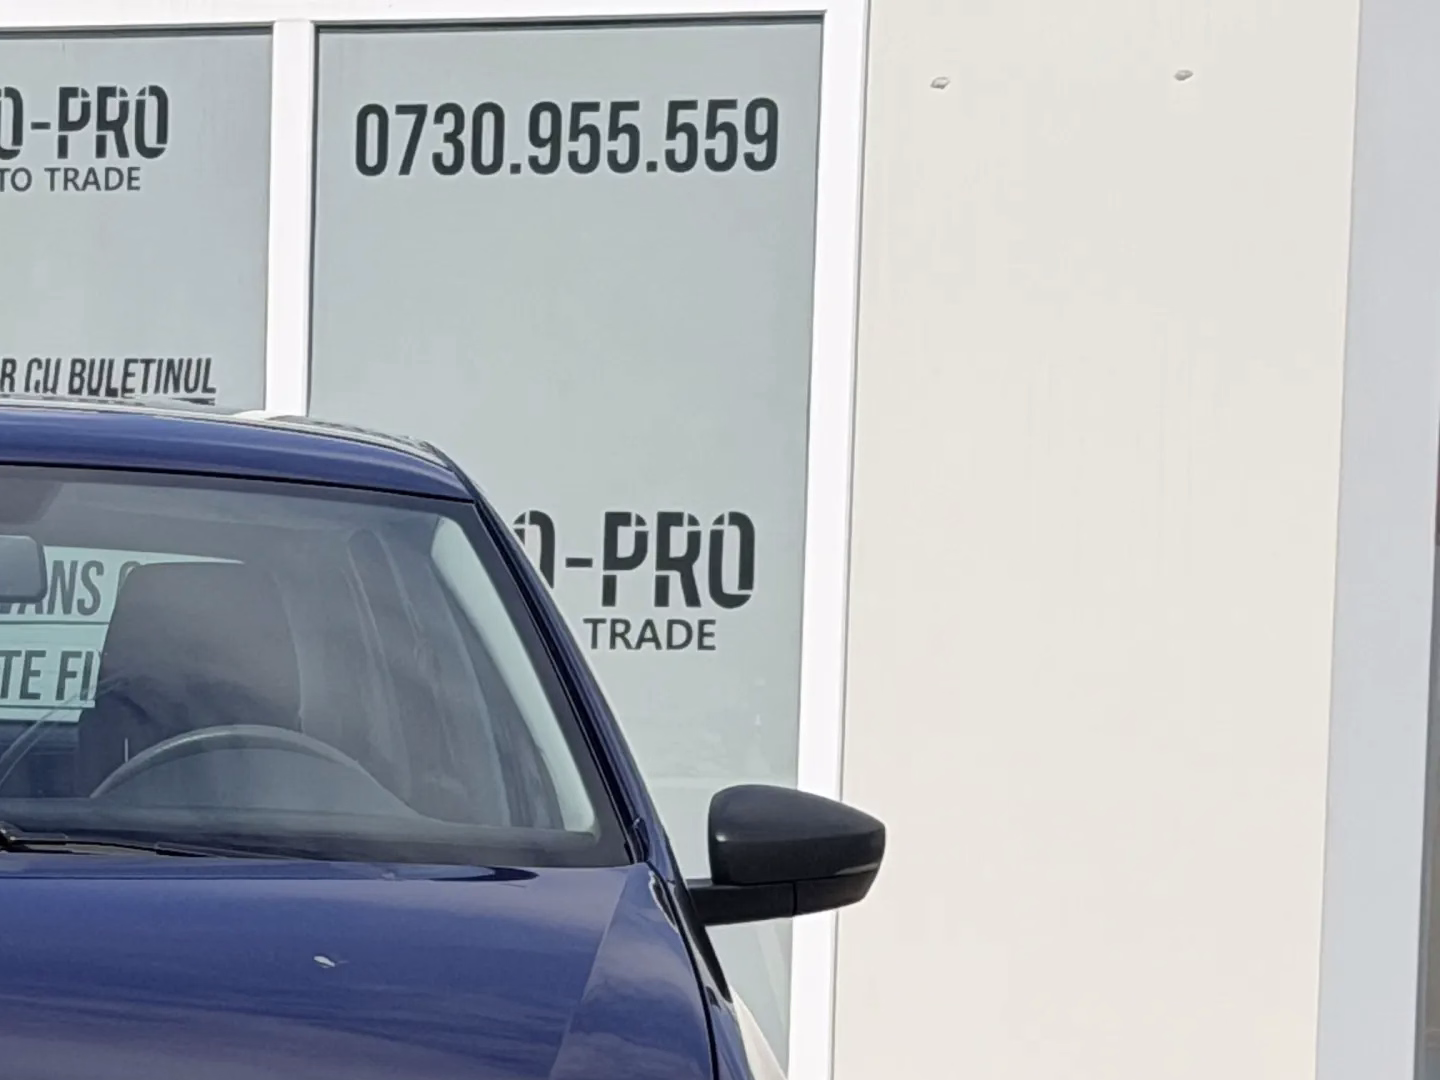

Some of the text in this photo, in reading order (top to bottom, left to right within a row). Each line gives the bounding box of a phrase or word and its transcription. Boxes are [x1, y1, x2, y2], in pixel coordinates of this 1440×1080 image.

[355, 97, 779, 177] 0730.955.559
[44, 166, 141, 192] TRADE
[68, 357, 217, 398] BULETINUL
[513, 510, 756, 610] O-PRO
[582, 618, 717, 651] TRADE
[55, 650, 96, 701] FI
